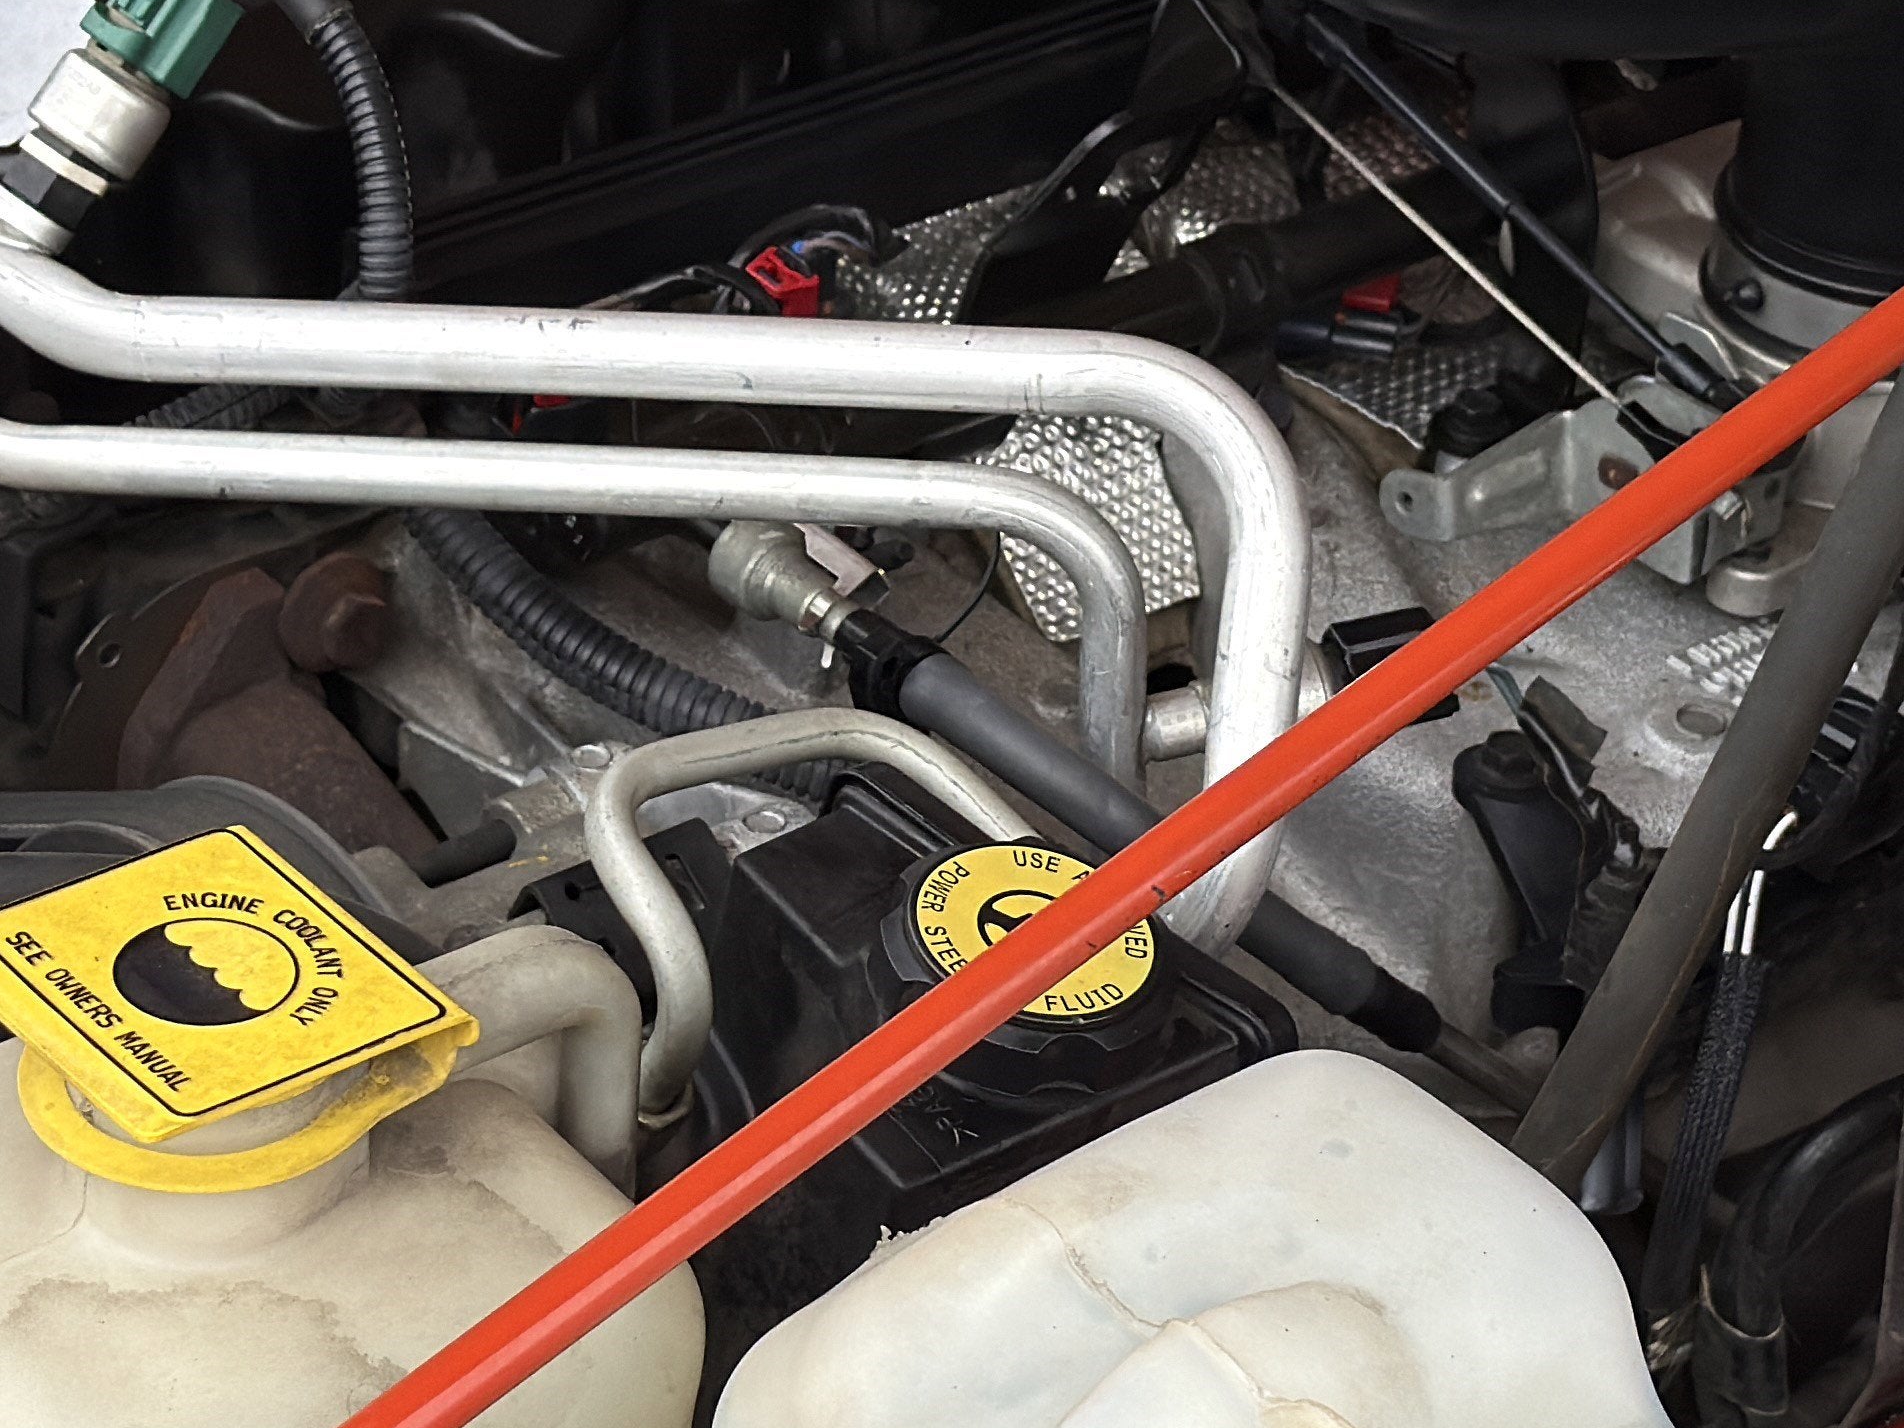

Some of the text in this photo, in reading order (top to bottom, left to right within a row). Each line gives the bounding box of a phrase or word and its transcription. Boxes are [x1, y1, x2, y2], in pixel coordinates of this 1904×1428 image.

[1012, 849, 1062, 874] USE
[162, 890, 345, 1028] ENGINE COOLANT ONLY
[920, 860, 971, 914] POWER
[1044, 981, 1125, 1013] FLUID
[5, 929, 194, 1094] SEE OWNERS MANUAL
